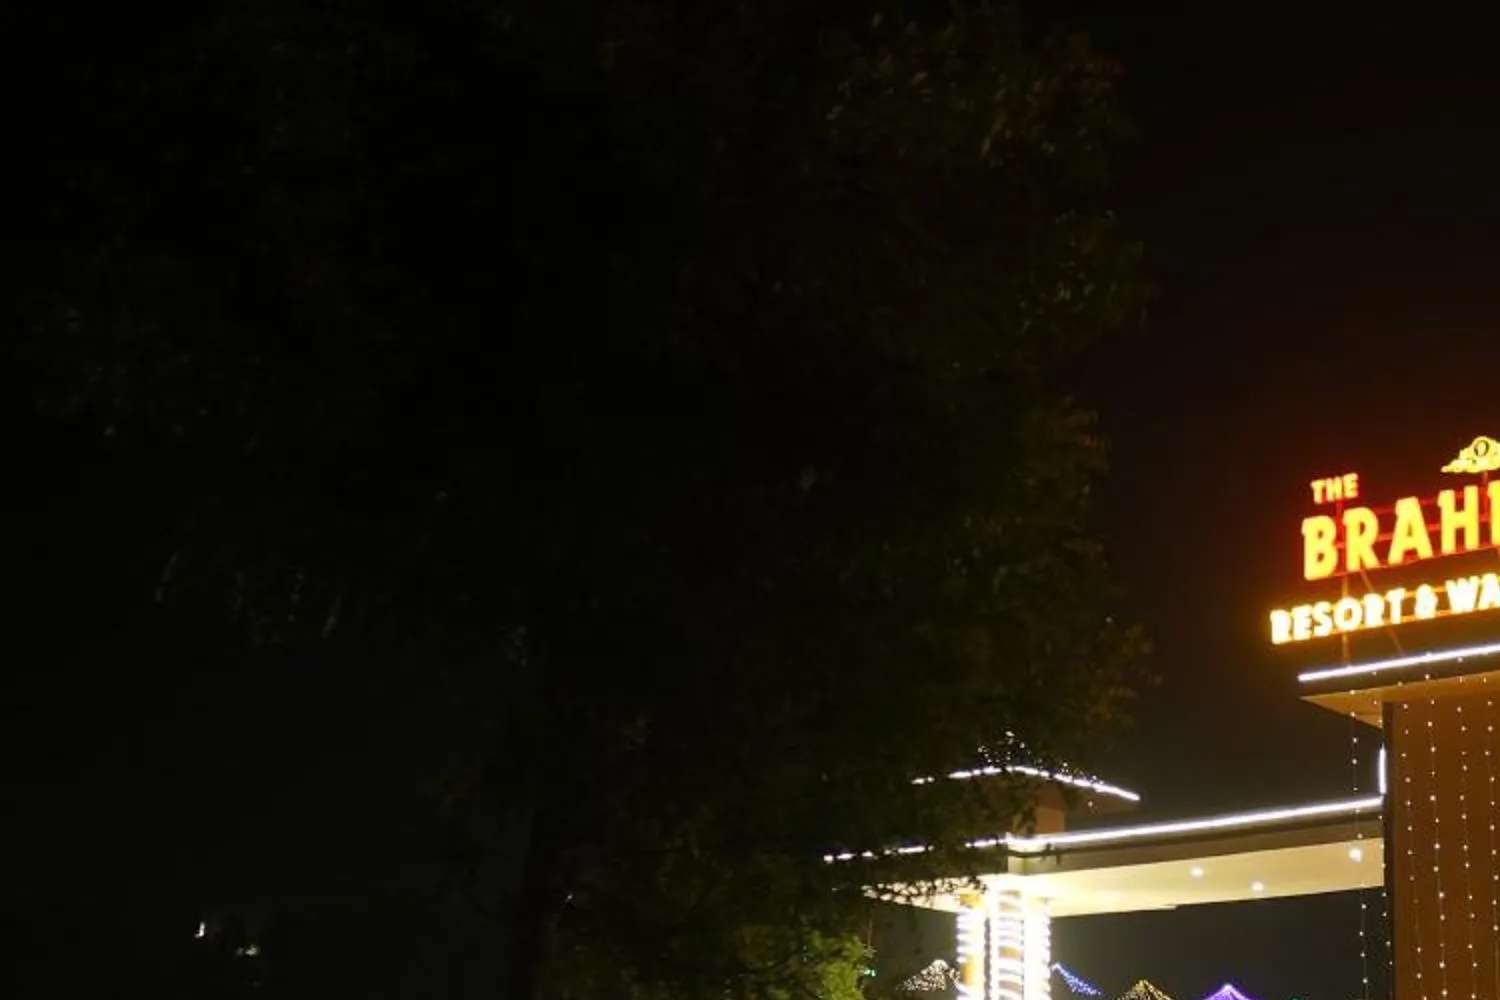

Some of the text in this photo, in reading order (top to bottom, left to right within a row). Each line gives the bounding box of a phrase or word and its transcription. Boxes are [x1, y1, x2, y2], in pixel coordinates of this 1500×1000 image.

[1311, 473, 1358, 504] THE
[1270, 588, 1405, 645] RESORT
[1414, 584, 1438, 620] &
